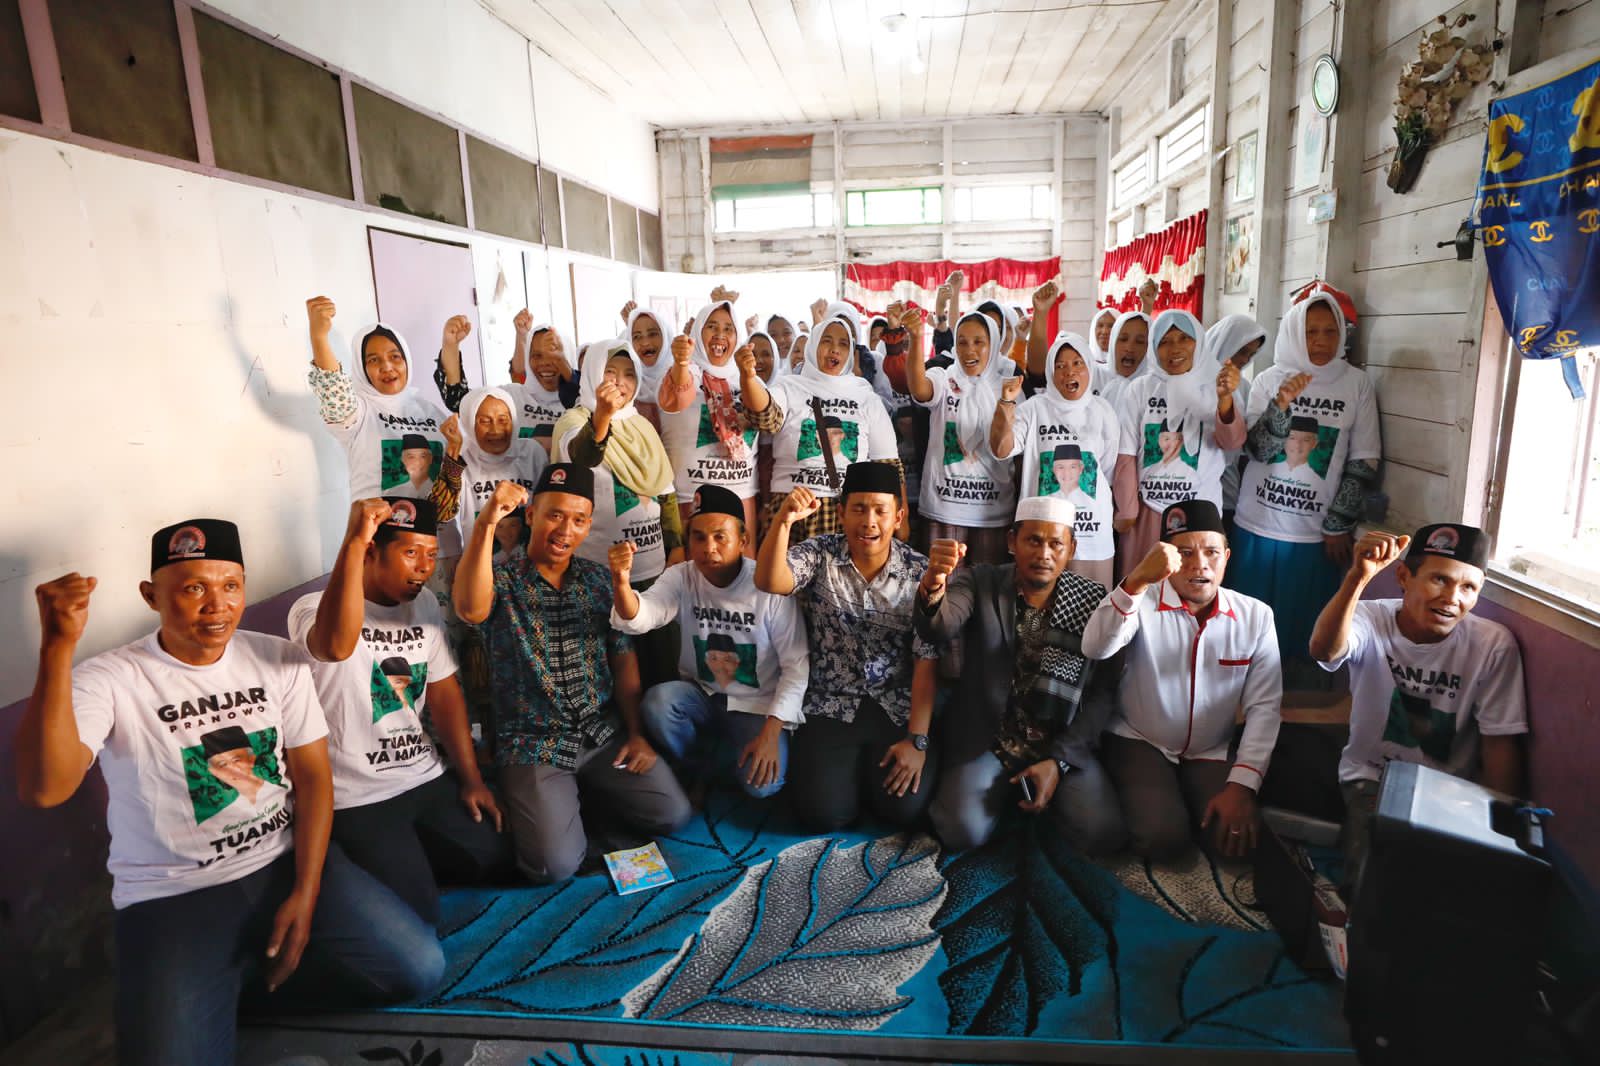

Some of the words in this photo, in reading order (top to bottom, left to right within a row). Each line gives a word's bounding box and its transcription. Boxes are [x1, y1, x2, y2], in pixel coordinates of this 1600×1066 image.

[524, 404, 562, 417] GANJ
[806, 398, 858, 409] NJAR
[1290, 396, 1345, 412] ANJAR
[1039, 425, 1070, 435] GAN
[697, 460, 747, 470] TUANKU
[687, 469, 704, 479] YA
[708, 468, 753, 480] RAKYAT
[944, 478, 994, 490] TUANKU
[1264, 478, 1317, 500] TUANKU
[936, 486, 951, 497] YA
[954, 490, 1000, 501] RAKYAT
[1146, 491, 1198, 501] RAKYAT
[1256, 485, 1265, 499] YA
[1267, 492, 1323, 512] RAKYAT
[622, 522, 660, 538] TUANK
[1073, 522, 1100, 531] KYAT
[693, 606, 756, 625] GANJAR
[362, 626, 424, 644] GANJAR
[158, 687, 268, 723] GANJAR
[170, 705, 265, 733] PRANOWO
[366, 751, 390, 765] YA
[210, 808, 289, 853] TUANKU
